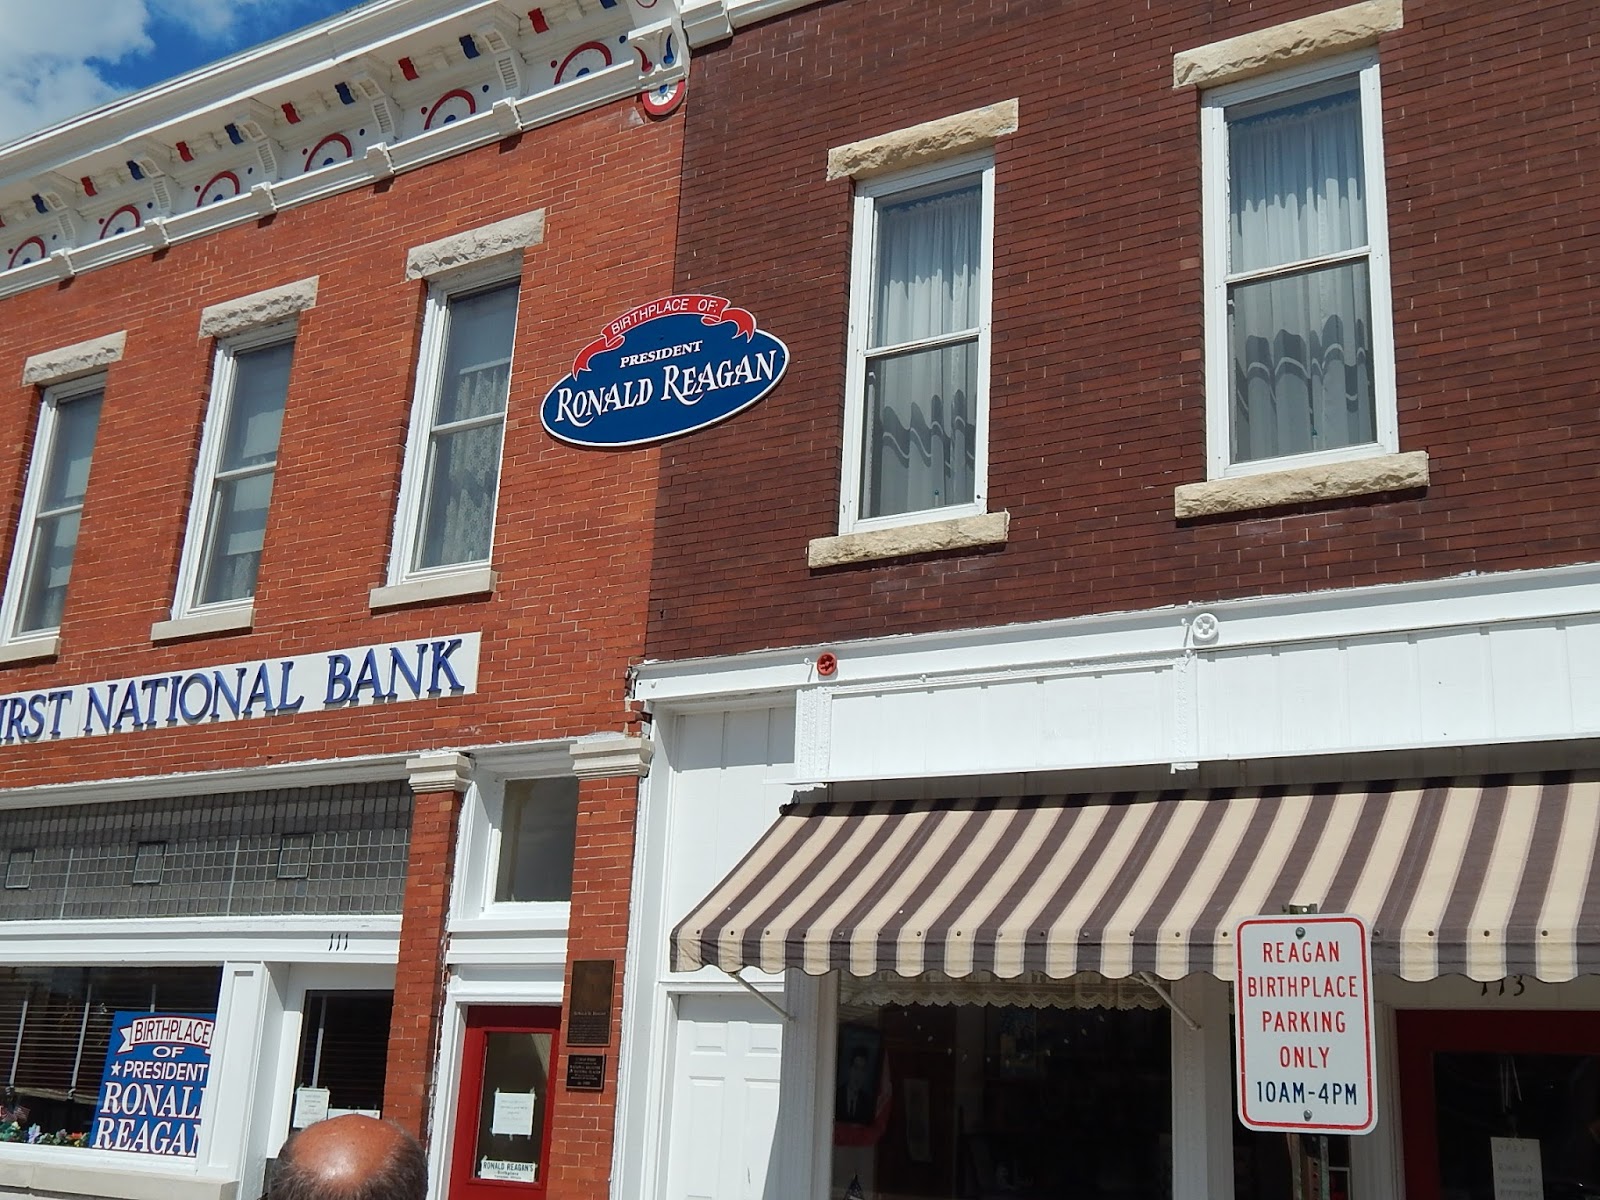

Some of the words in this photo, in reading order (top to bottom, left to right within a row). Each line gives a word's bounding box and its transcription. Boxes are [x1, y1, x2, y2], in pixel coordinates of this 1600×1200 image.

[611, 298, 689, 335] BIRTHPLACE
[697, 299, 719, 314] OF:
[619, 340, 703, 368] PRESIDENT
[554, 378, 653, 427] RONALD
[661, 350, 777, 406] REAGAN
[83, 661, 304, 732] NATIONAL
[324, 638, 465, 704] BANK
[1262, 941, 1340, 963] REAGAN
[1248, 975, 1358, 998] BIRTHPLACE
[134, 1019, 212, 1045] BIRTHPLACE
[1262, 1010, 1346, 1033] PARKING
[152, 1046, 185, 1058] OF
[1279, 1046, 1330, 1069] ONLY
[122, 1060, 208, 1082] PRESIDENT
[1256, 1081, 1357, 1105] 10AM-4PM
[483, 1162, 504, 1170] RONALD
